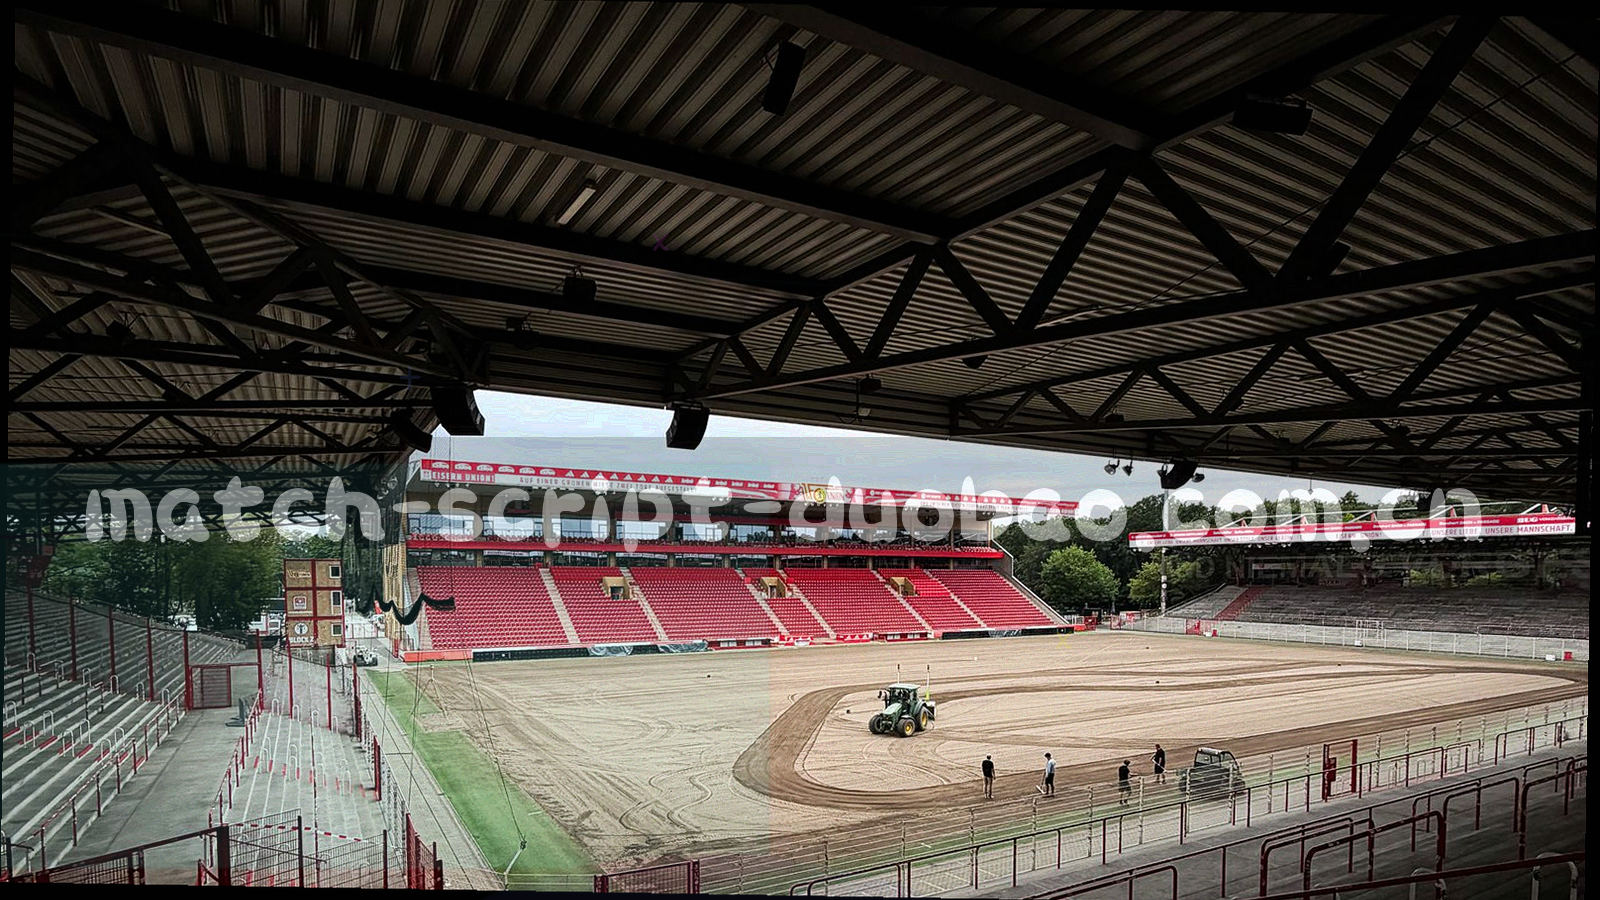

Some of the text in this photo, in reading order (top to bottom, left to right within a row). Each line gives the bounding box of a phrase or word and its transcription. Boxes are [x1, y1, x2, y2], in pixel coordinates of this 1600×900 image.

[432, 471, 495, 483] EISERN UNION!
[1485, 525, 1513, 534] UNSERE
[1517, 524, 1573, 533] MANNSCHAFT.
